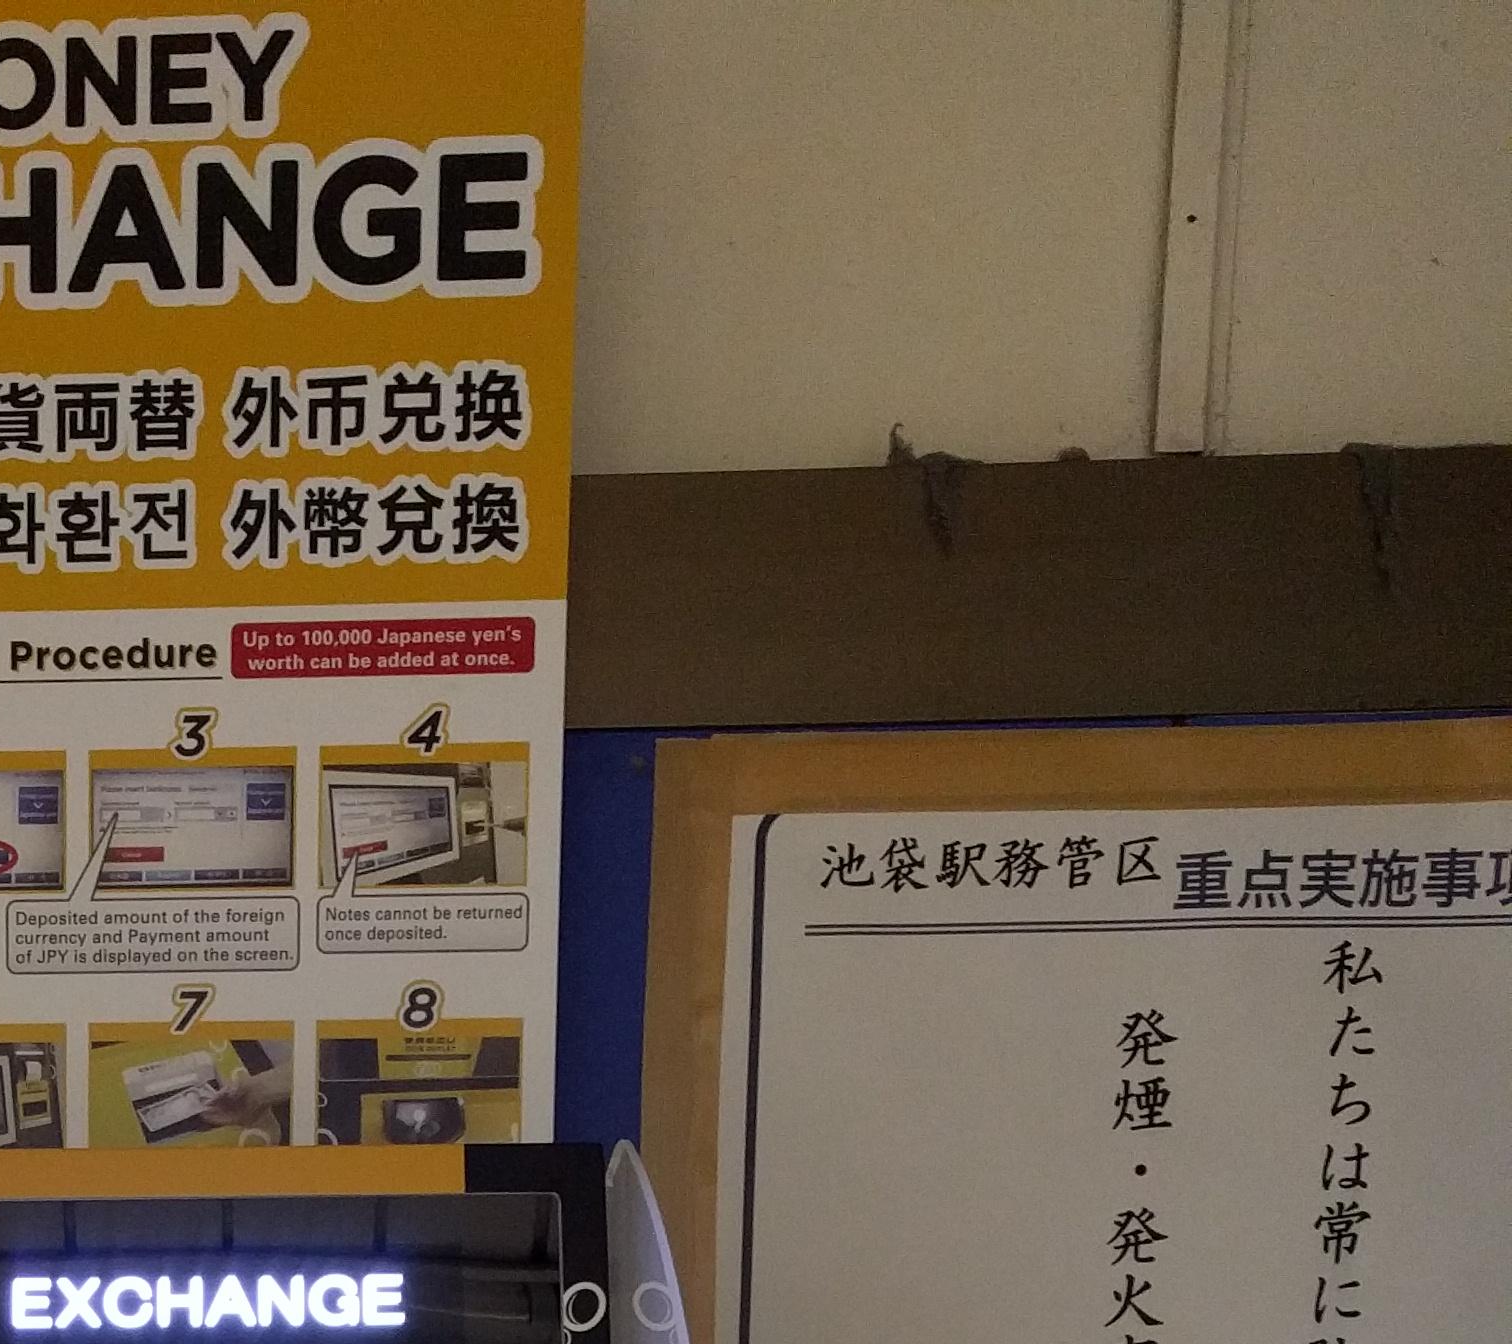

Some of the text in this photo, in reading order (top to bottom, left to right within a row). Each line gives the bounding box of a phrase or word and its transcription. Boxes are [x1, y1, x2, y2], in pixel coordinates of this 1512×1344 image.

[243, 625, 522, 650] Up to 100,000 Japanese yen's
[10, 637, 218, 671] Procedure
[248, 651, 516, 671] worth can be added at once.
[174, 712, 212, 757] 3
[406, 710, 443, 753] 4
[818, 834, 1163, 893] 池袋駅務管区
[15, 908, 285, 927] Deposited amount of the foreign
[325, 905, 524, 922] Notes cannot be returned
[15, 928, 270, 948] currency and Payment amount
[324, 926, 448, 943] once deposited.
[15, 947, 295, 966] of JPY is displayed on the screen.
[173, 990, 210, 1032] 7
[402, 986, 438, 1029] 8
[9, 1272, 407, 1330] EXCHANGE
